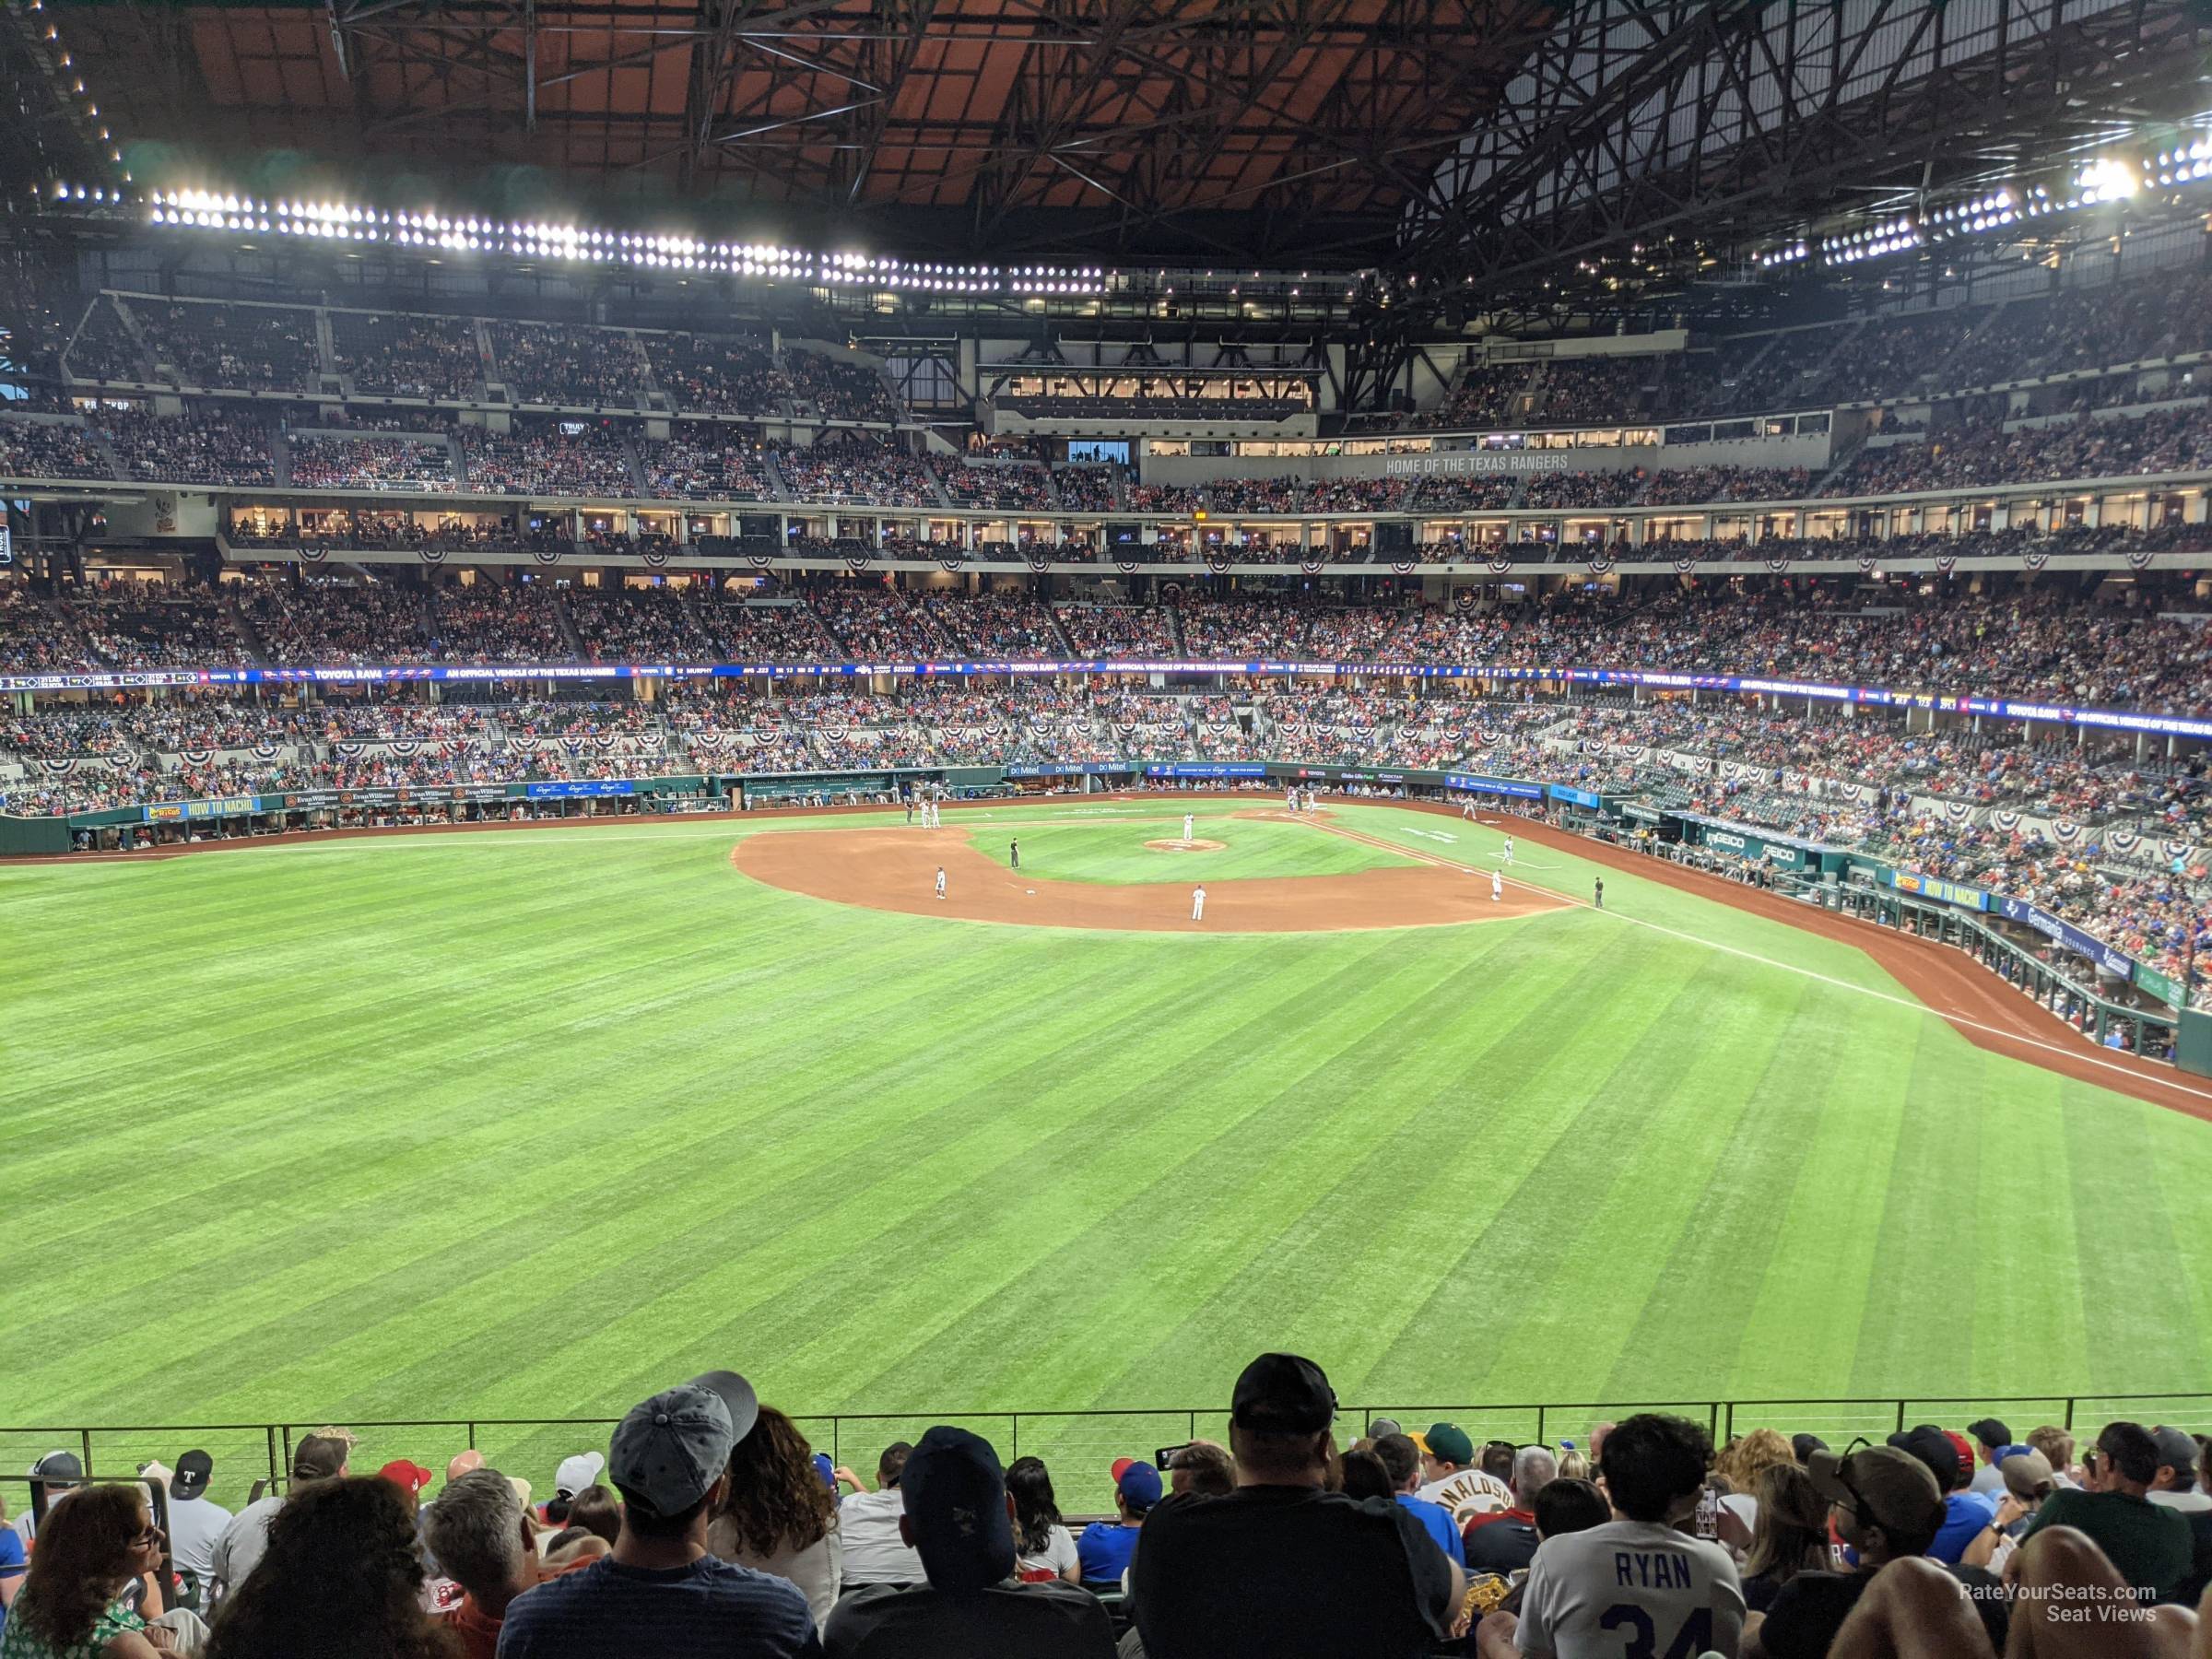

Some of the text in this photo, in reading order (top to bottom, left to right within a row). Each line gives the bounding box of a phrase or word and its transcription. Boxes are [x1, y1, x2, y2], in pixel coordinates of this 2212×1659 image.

[1387, 454, 1568, 474] HOME OF THE TEXAS RANGERS
[315, 670, 382, 679] TOYOTA RAV4
[1010, 664, 1038, 672] TOYOTA
[2006, 704, 2037, 718] TOYOTA
[1020, 766, 1040, 774] Mitel
[1108, 763, 1125, 771] Mitel
[188, 802, 209, 817] HOW
[211, 801, 222, 815] TO
[1716, 831, 1745, 849] GEICO
[1762, 843, 1795, 863] GEICO
[1924, 879, 1943, 899] HOW
[1944, 883, 1954, 901] TO
[2028, 906, 2095, 959] Germania INSURANCE
[183, 1470, 196, 1484] T
[1615, 1552, 1692, 1589] RYAN
[1599, 1604, 1712, 1659] 34
